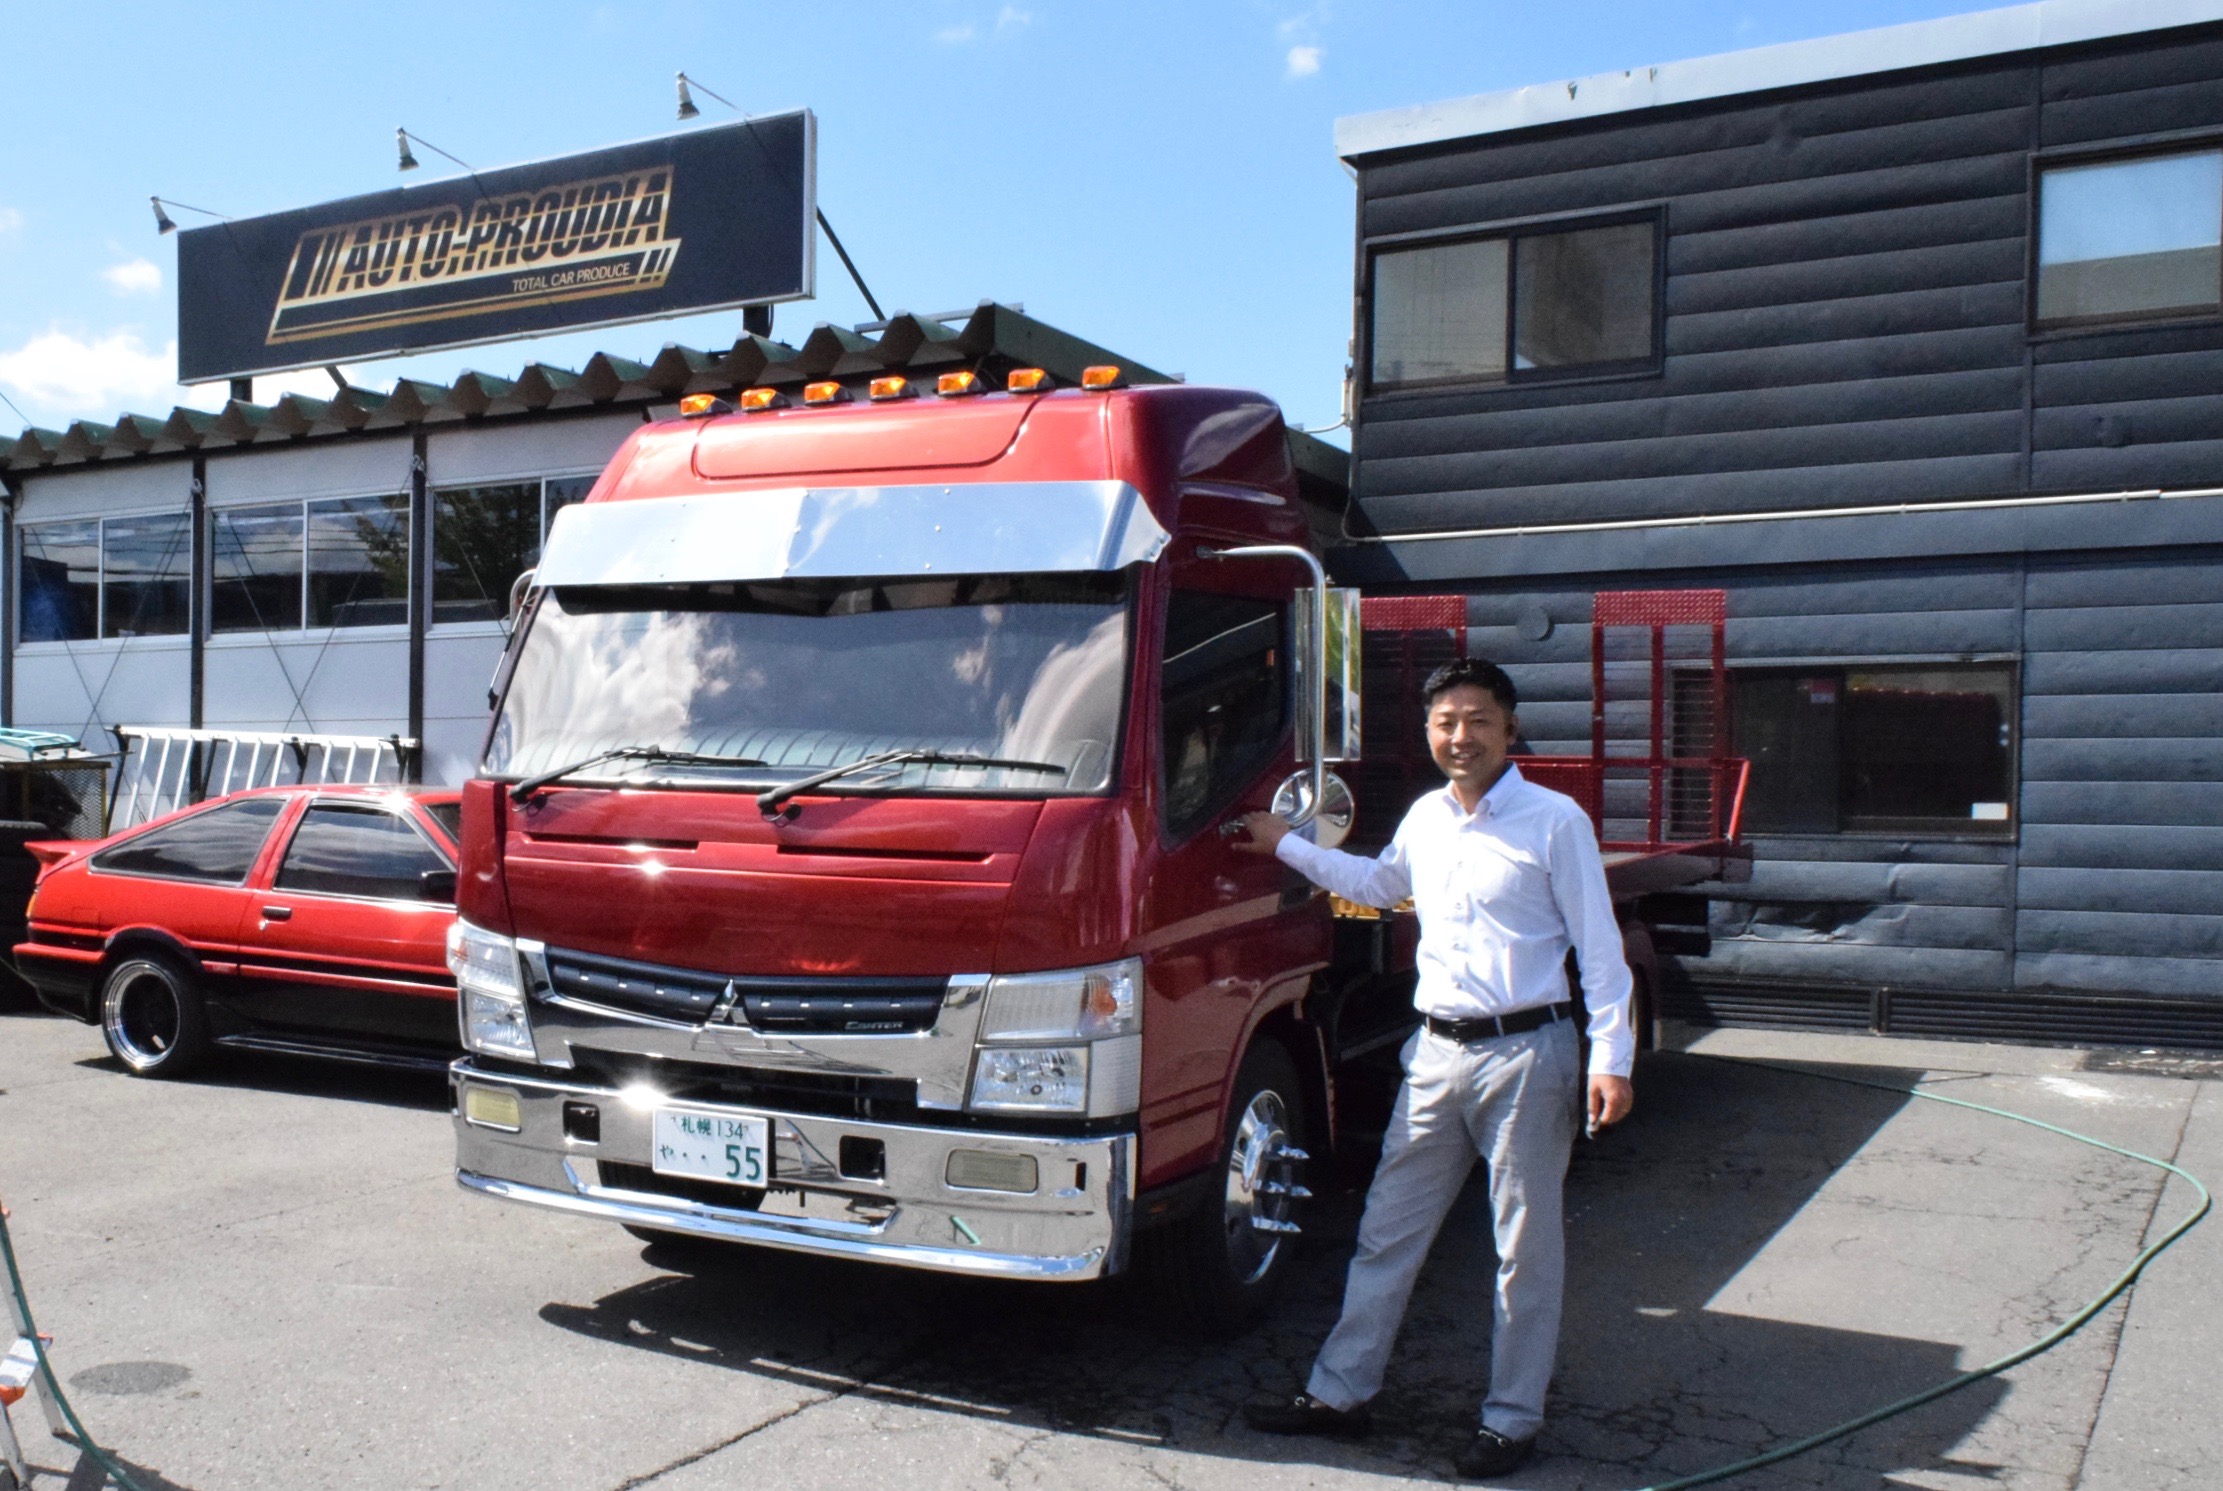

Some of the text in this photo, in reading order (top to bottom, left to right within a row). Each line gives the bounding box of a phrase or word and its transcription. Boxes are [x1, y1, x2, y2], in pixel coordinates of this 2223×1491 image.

[334, 171, 668, 292] AUTO-PROUDIA
[513, 262, 630, 292] TOTAL CAR PRODUCE
